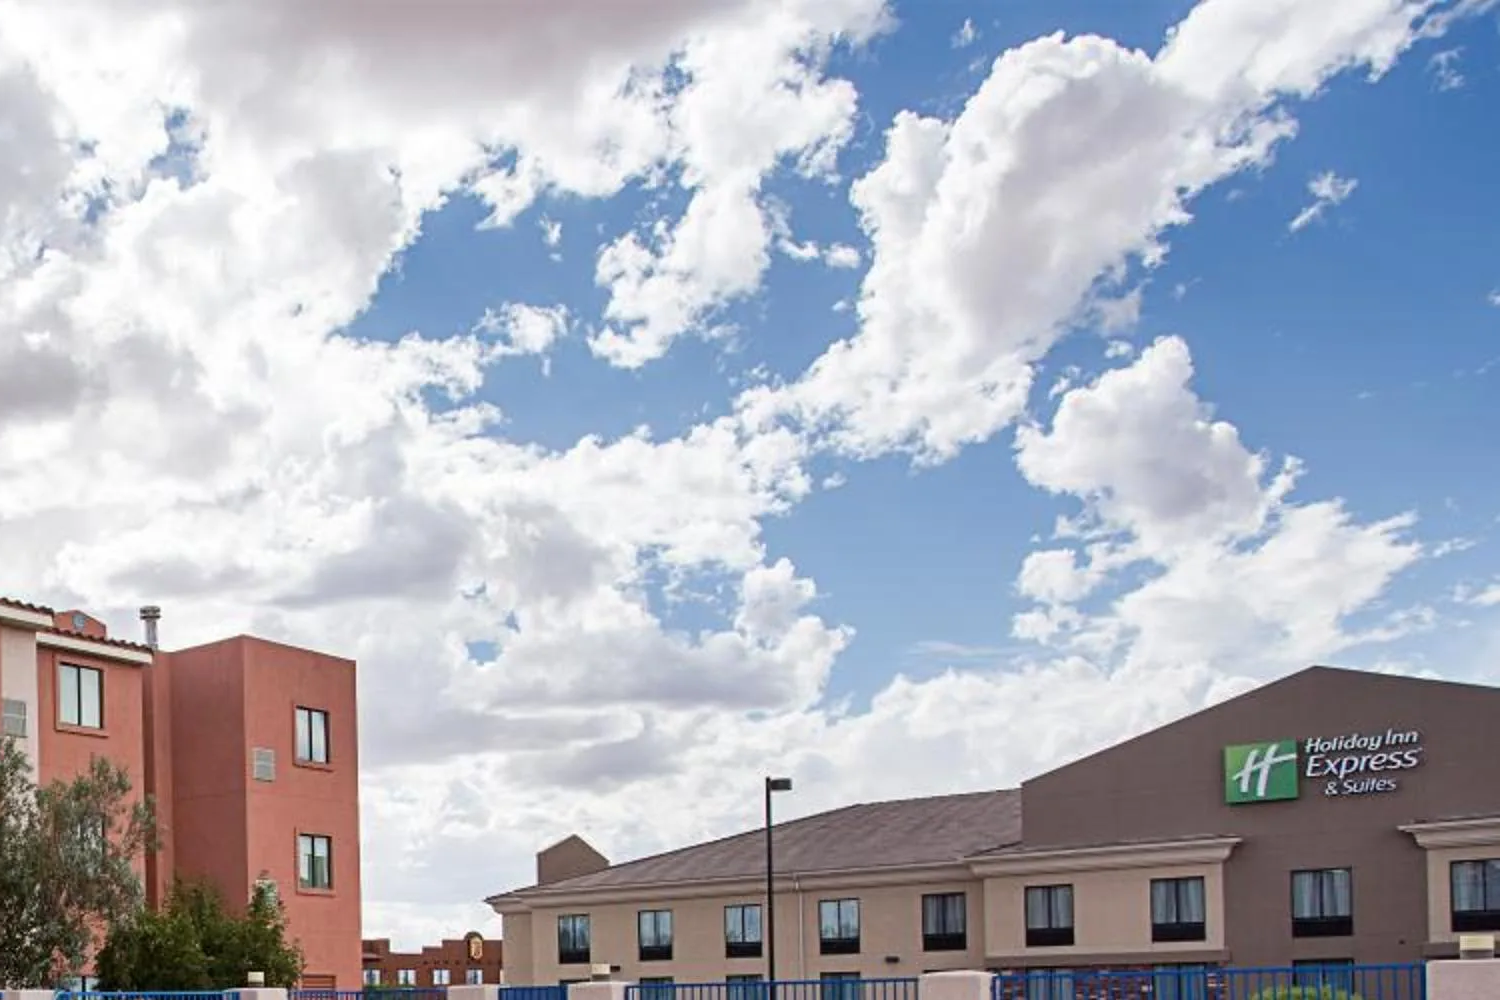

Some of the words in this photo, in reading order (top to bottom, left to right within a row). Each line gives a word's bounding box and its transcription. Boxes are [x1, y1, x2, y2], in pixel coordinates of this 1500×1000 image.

[1305, 733, 1382, 753] Holiday
[1386, 728, 1418, 745] Inn
[1306, 748, 1418, 778] Express
[1324, 781, 1338, 795] &
[1343, 777, 1397, 793] Suites
